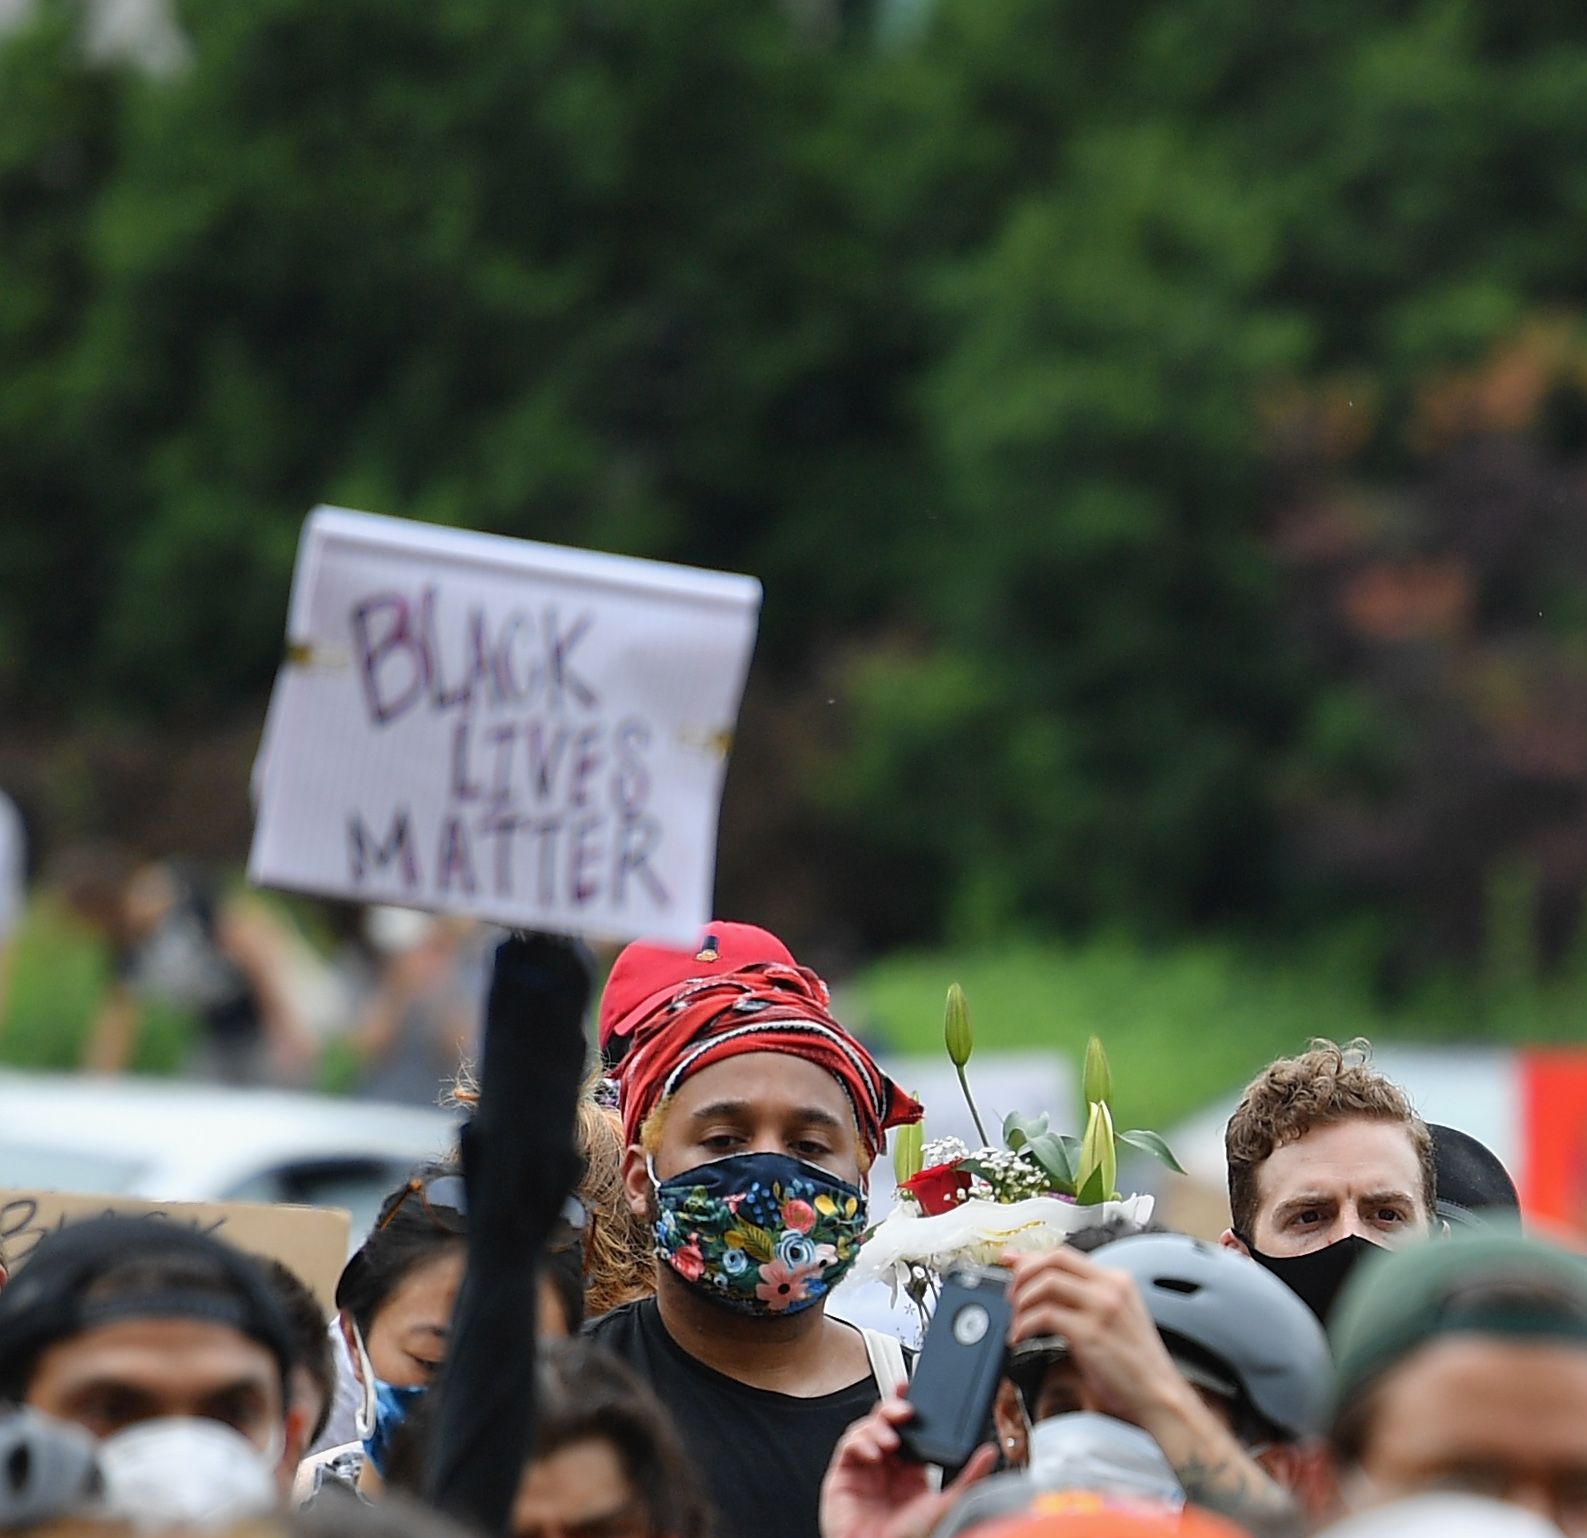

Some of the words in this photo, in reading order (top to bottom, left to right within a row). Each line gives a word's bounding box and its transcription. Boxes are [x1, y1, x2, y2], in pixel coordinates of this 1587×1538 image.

[351, 579, 599, 726] BLACK
[452, 716, 653, 817] LIVES
[347, 809, 673, 908] MATTER
